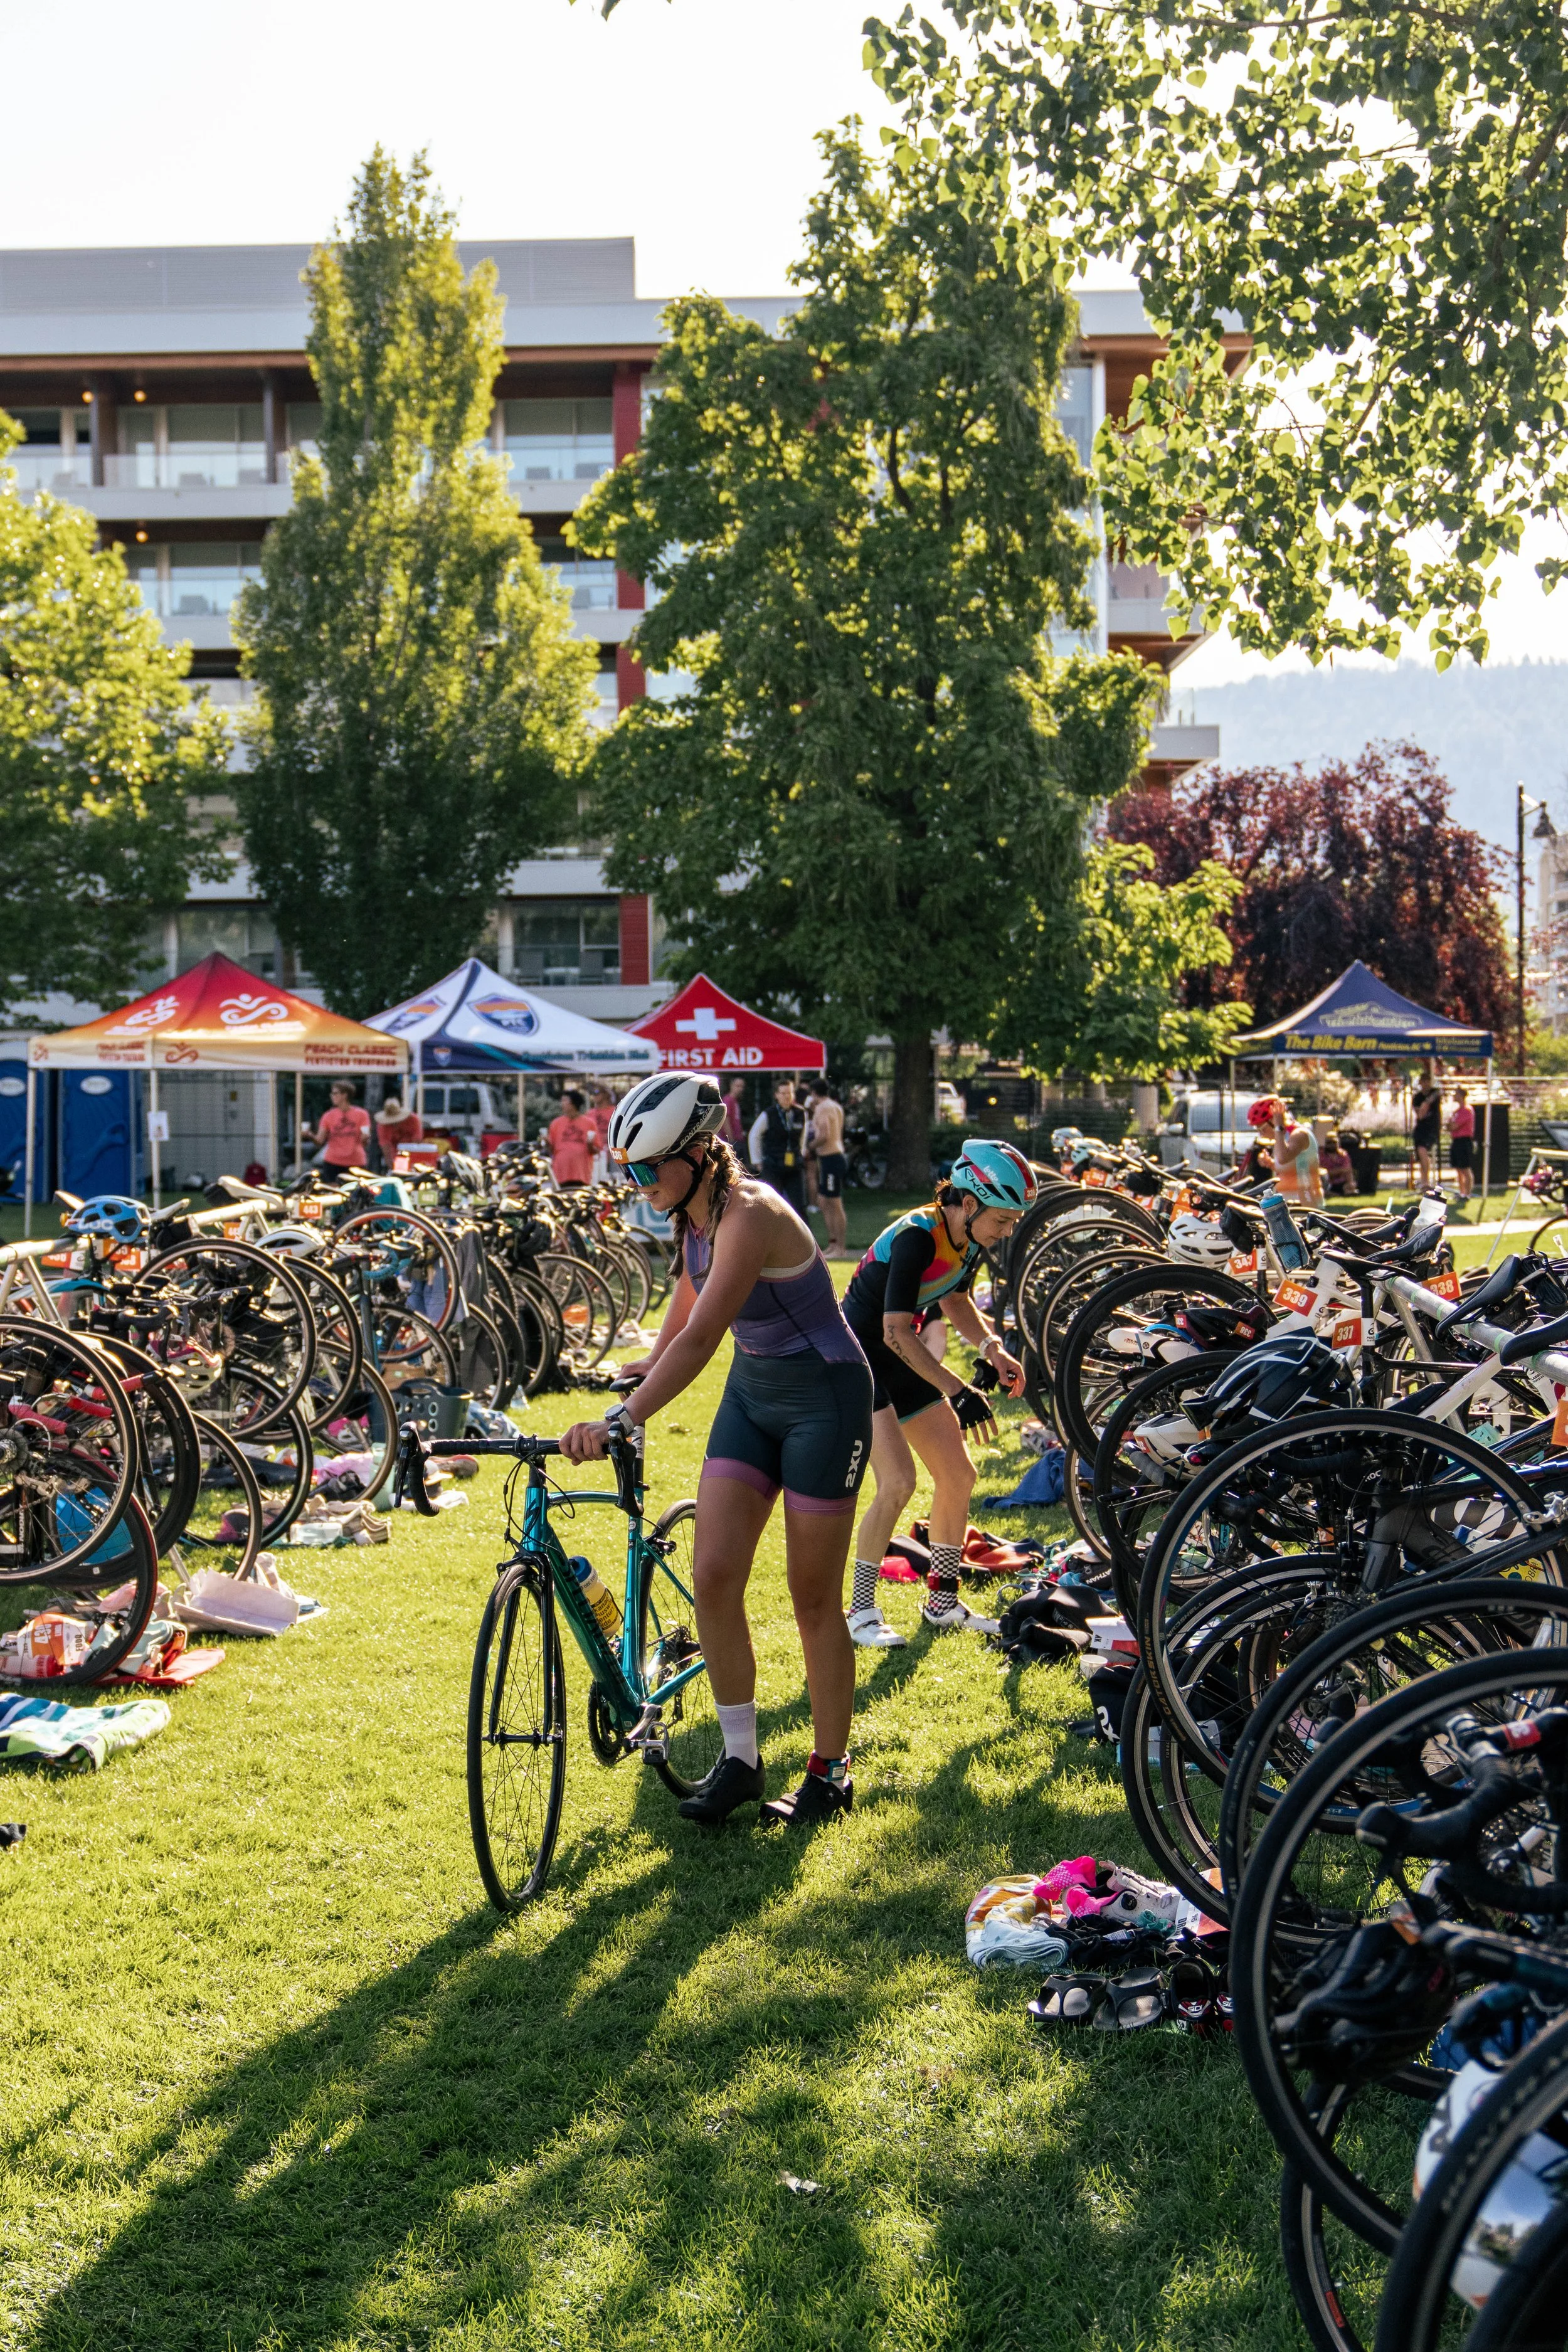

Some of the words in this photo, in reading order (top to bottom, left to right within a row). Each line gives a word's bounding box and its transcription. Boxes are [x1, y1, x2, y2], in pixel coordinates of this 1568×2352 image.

[1286, 1035, 1310, 1050] The
[1311, 1035, 1342, 1050] Bike
[1343, 1036, 1378, 1050] Barn
[659, 1049, 716, 1066] FIRST
[723, 1046, 764, 1066] AID
[680, 1105, 712, 1147] BONTRAGER
[1234, 1255, 1253, 1269] 343
[1429, 1279, 1454, 1295] 338
[1283, 1288, 1308, 1308] 339
[1240, 1325, 1252, 1337] 338
[1337, 1325, 1354, 1342] 337
[845, 1439, 863, 1488] 2XU
[1085, 1569, 1112, 1585] ATHAN
[75, 1634, 83, 1651] FOOD
[1143, 1635, 1172, 1716] GATORSKIN
[1096, 1705, 1120, 1744] XU
